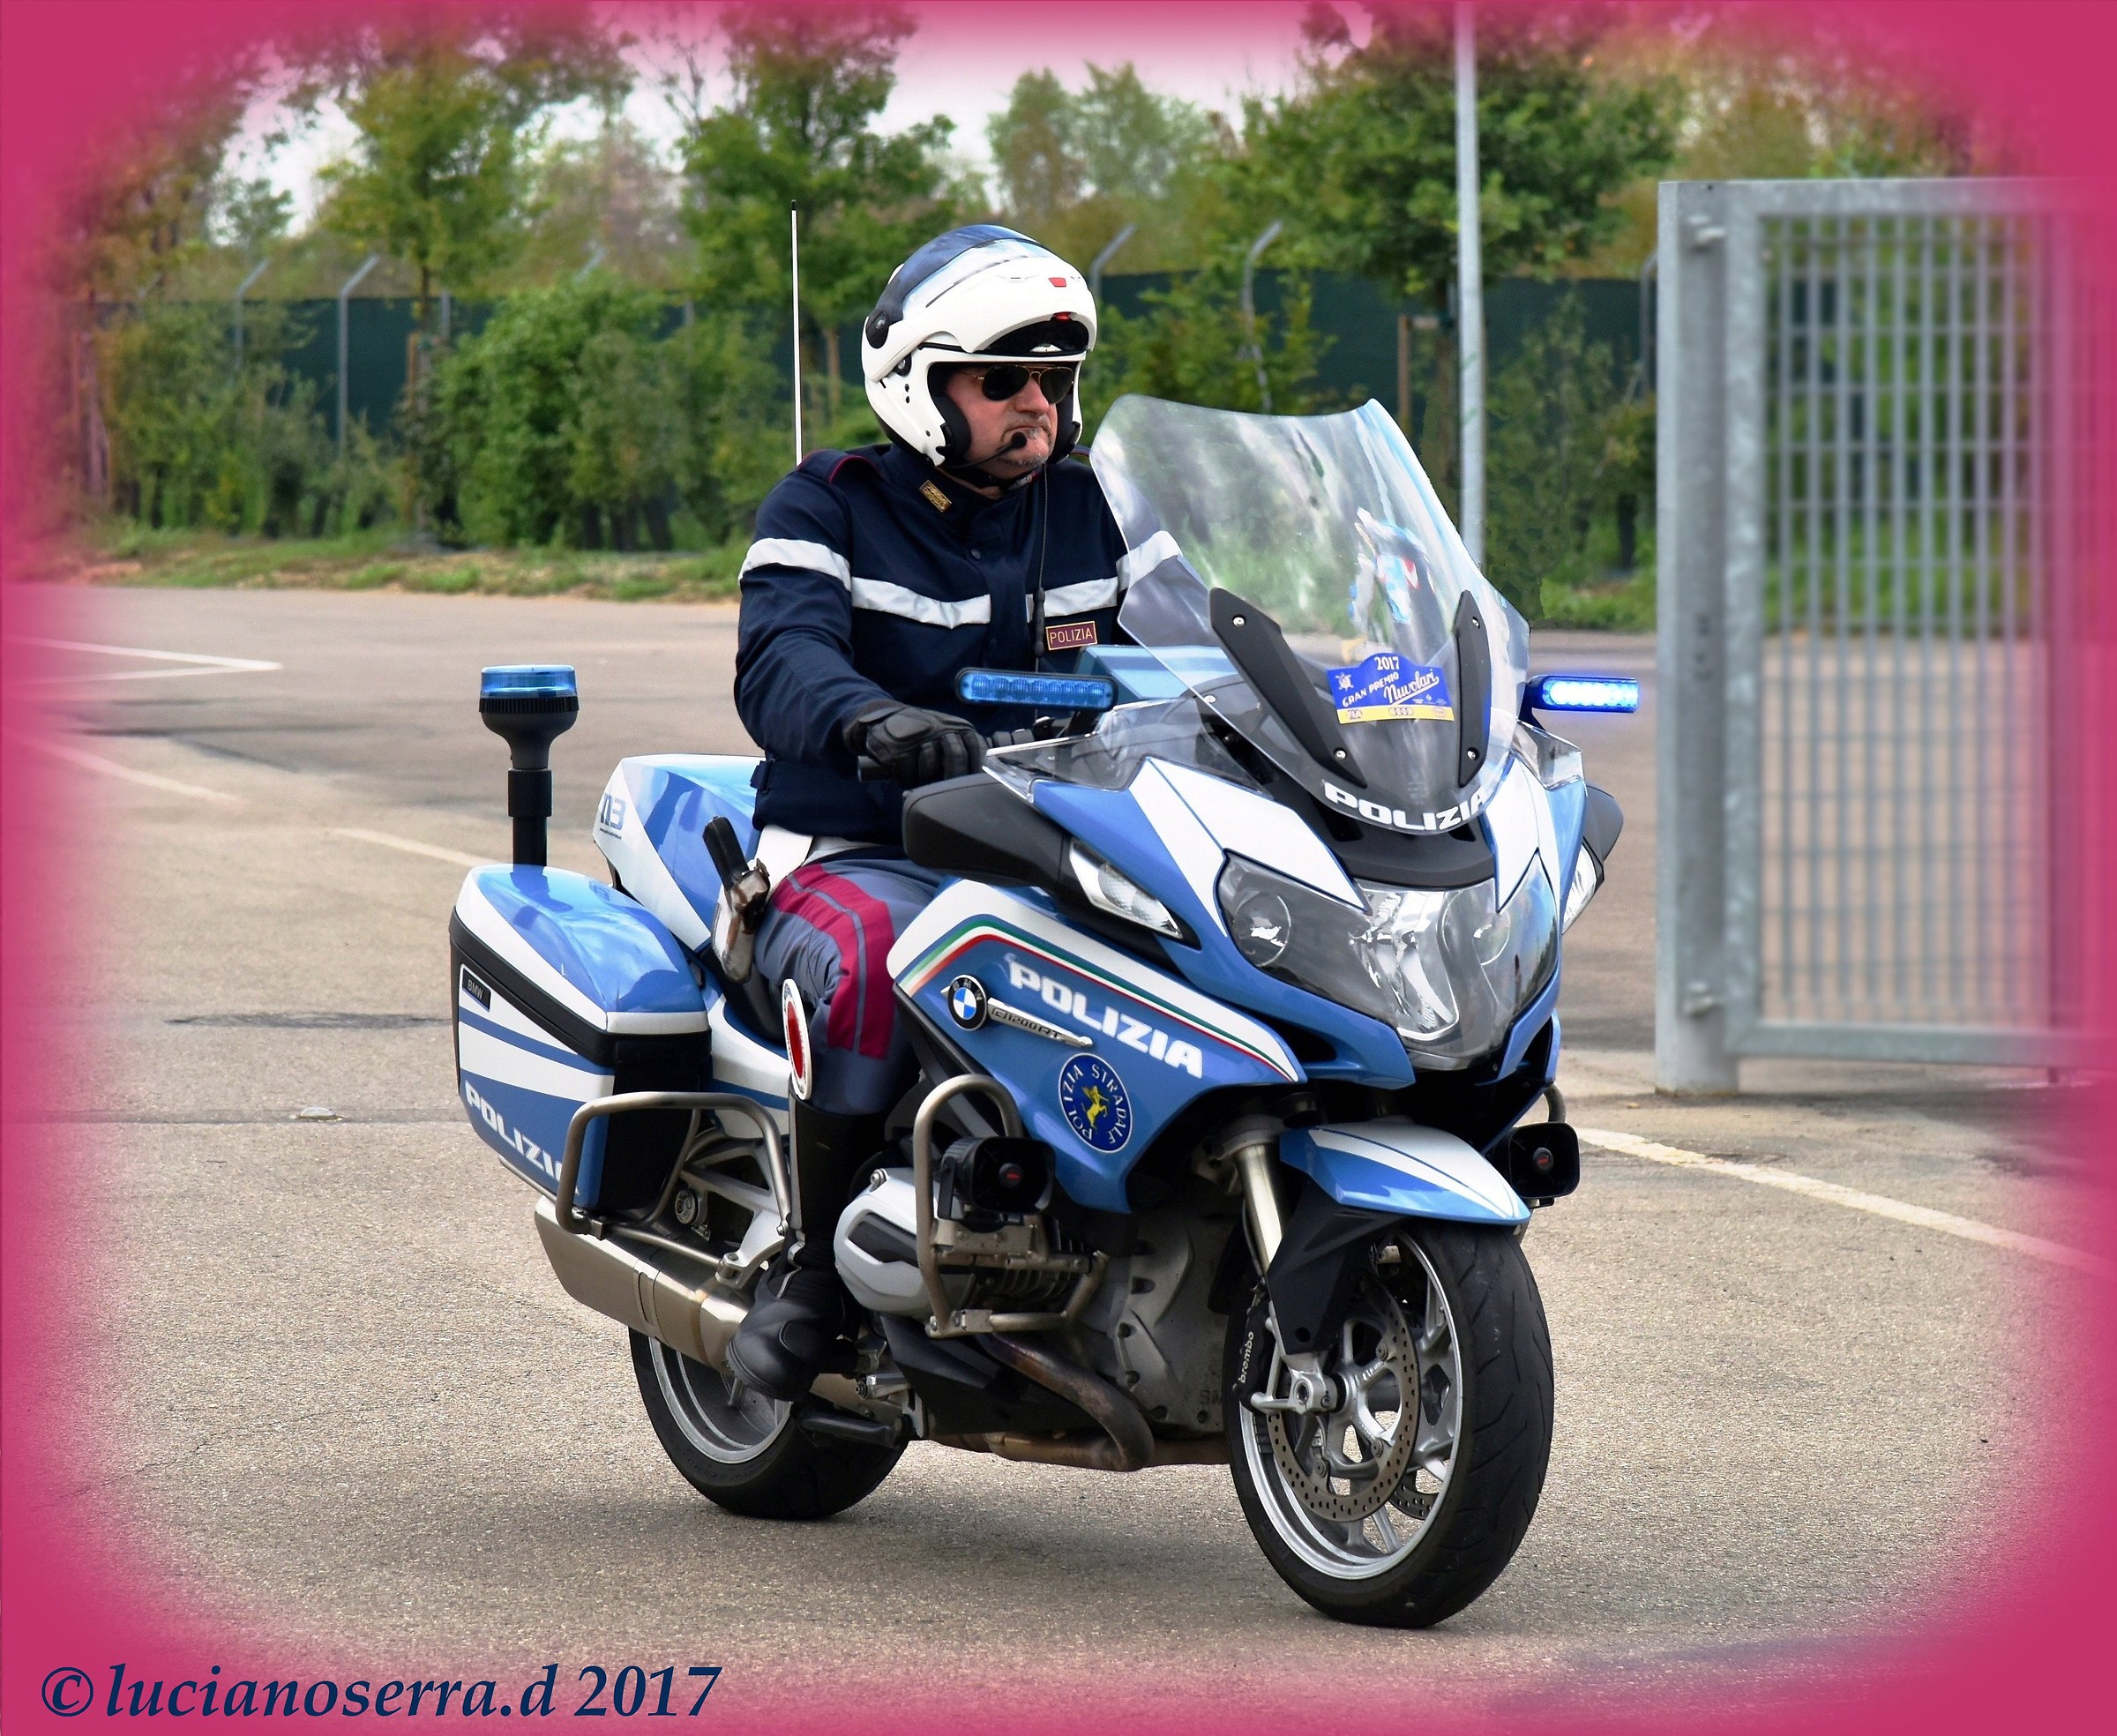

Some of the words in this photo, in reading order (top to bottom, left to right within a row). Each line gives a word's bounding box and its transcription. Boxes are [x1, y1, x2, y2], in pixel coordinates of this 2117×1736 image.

[1050, 627, 1093, 644] POLIZIA
[1374, 656, 1400, 670] 2017
[1342, 688, 1367, 707] GRAN
[1368, 671, 1400, 694] PREMIO
[1324, 781, 1485, 831] POLIZIA
[468, 979, 484, 999] BMW
[1009, 958, 1203, 1079] POLIZIA
[1238, 1330, 1254, 1384] brembo
